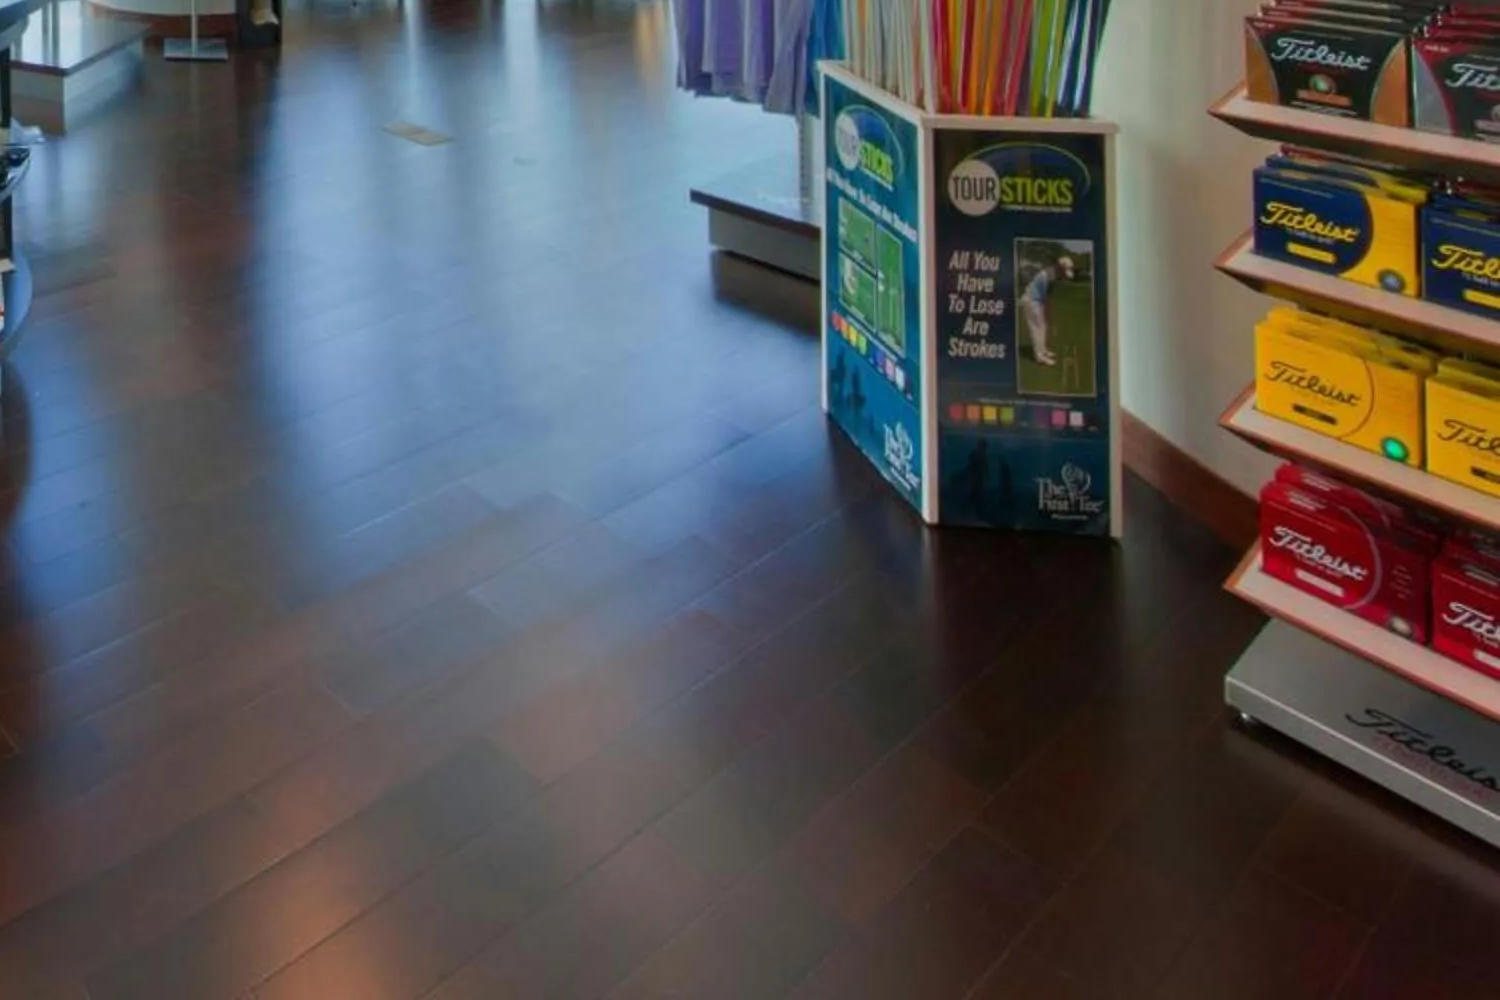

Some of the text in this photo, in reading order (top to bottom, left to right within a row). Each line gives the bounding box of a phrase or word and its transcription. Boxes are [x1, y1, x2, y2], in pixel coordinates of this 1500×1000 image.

[1271, 36, 1372, 71] Titleist
[951, 176, 1074, 206] TOUR STICKS
[1260, 200, 1361, 243] Titleist
[948, 250, 1001, 271] All You
[1431, 244, 1500, 280] Titl
[956, 273, 994, 293] Have
[948, 294, 1005, 316] To Lose
[962, 316, 990, 336] Are
[948, 337, 1006, 359] Strokes
[1264, 360, 1362, 407] Titleist
[1436, 418, 1500, 458] Titl
[1032, 477, 1067, 497] The
[1268, 525, 1369, 582] Titleist
[1345, 708, 1500, 794] Titleis
